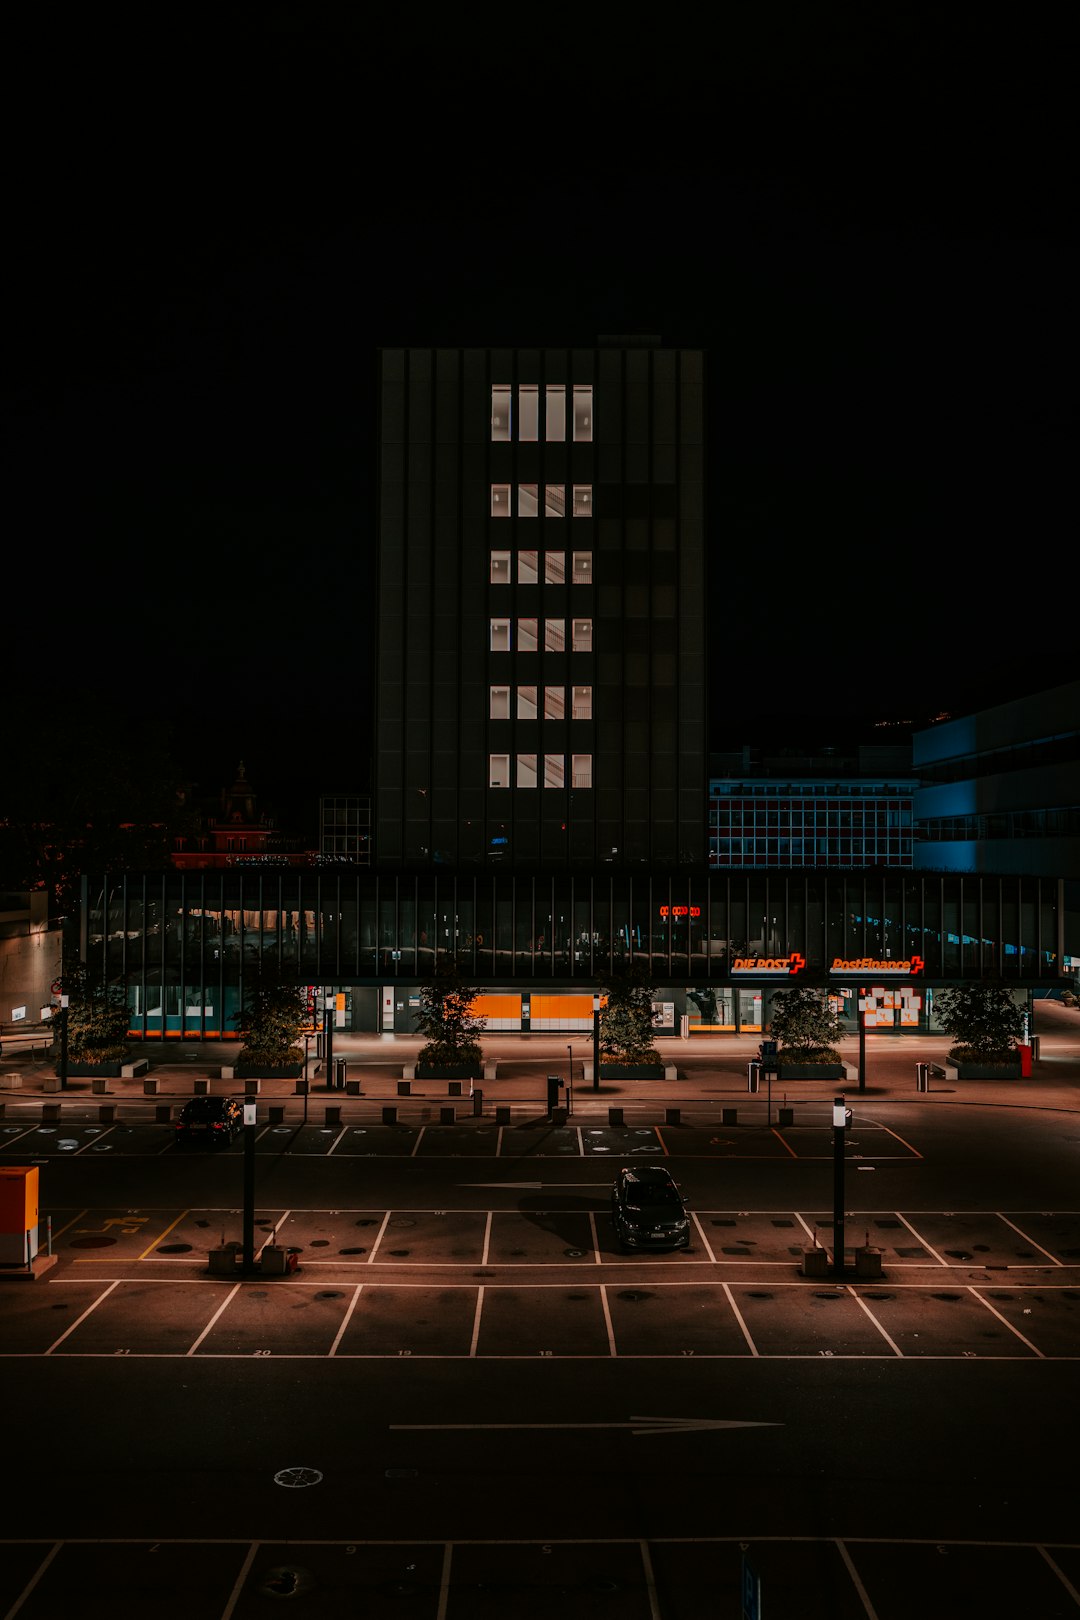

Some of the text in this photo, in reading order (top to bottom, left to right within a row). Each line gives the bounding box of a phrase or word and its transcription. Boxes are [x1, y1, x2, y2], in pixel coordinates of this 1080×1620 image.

[733, 958, 790, 969] DIE POST
[832, 957, 911, 970] PostFinance
[148, 1543, 161, 1553] 7
[542, 1544, 552, 1554] 5
[738, 1542, 750, 1551] 4
[936, 1545, 949, 1554] 3
